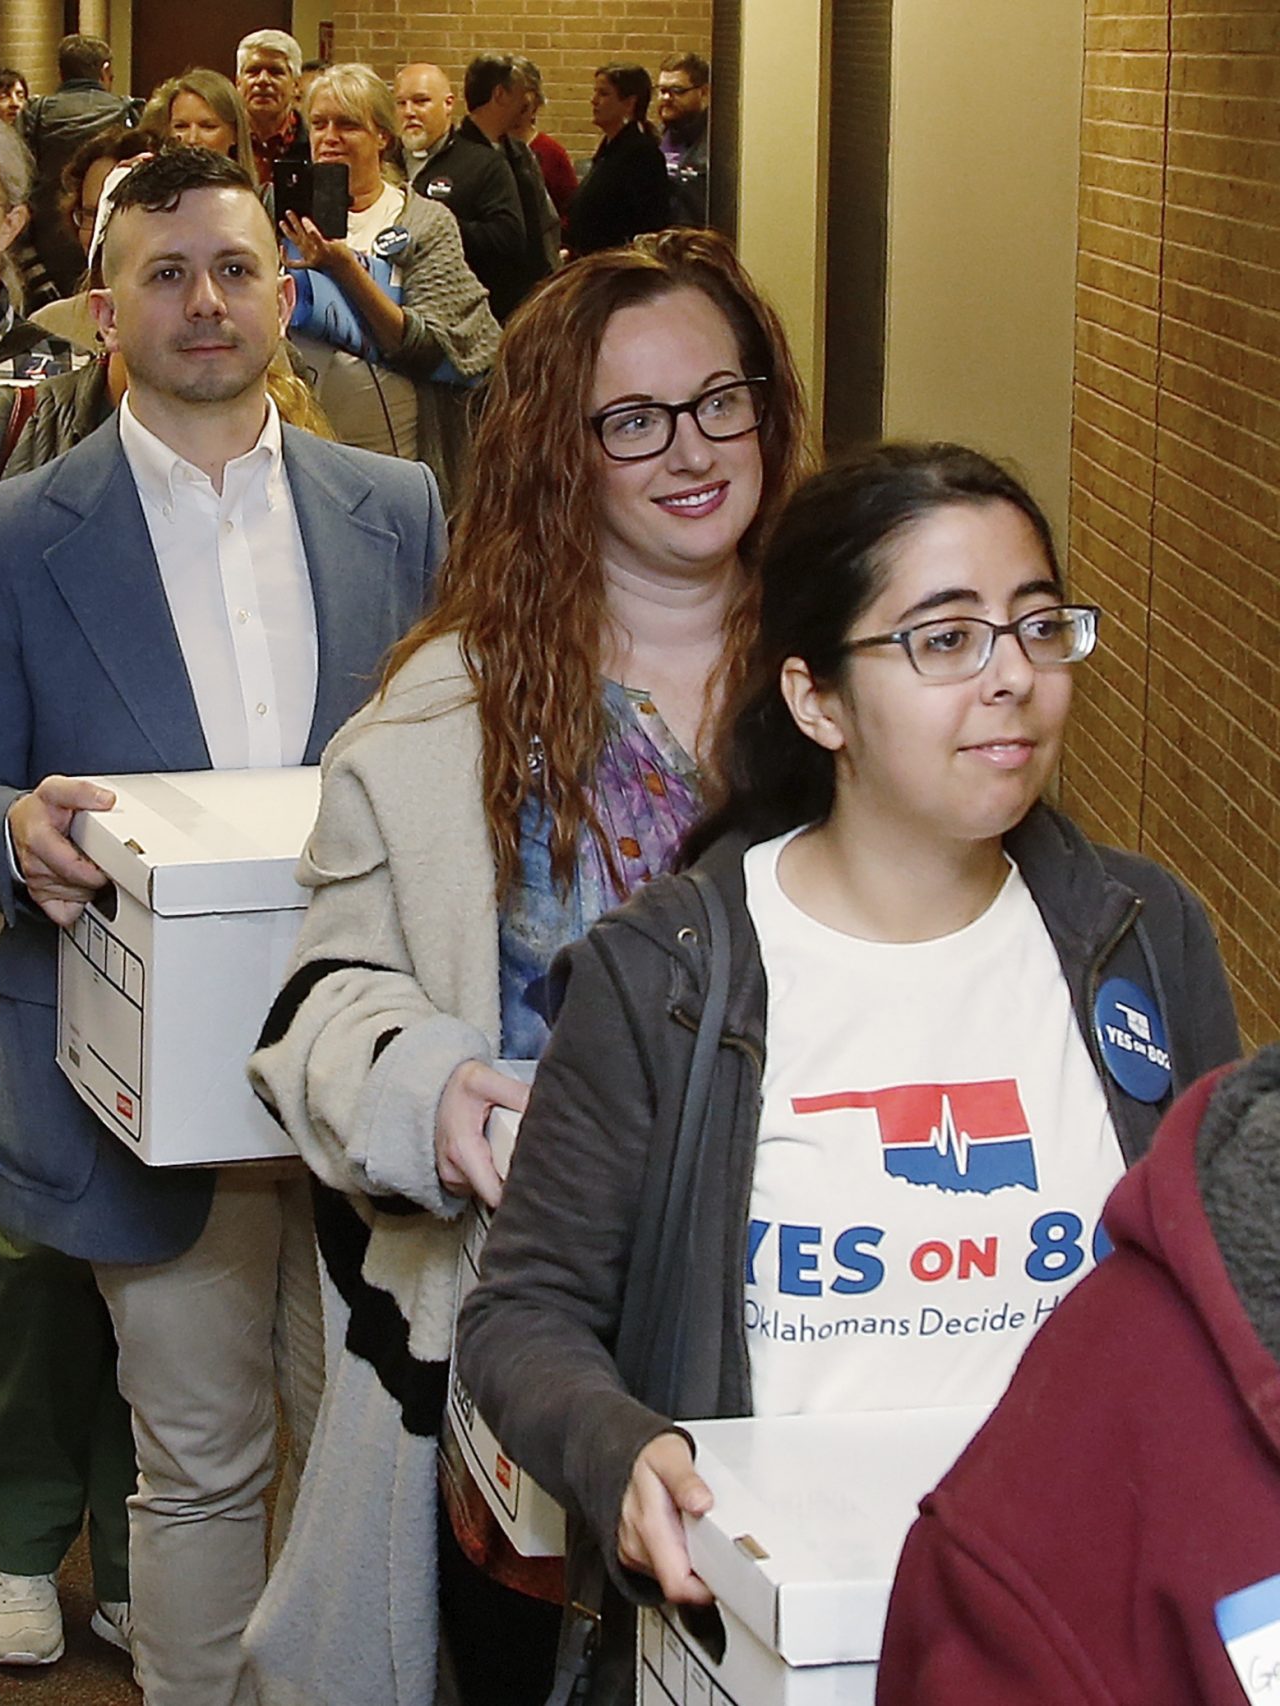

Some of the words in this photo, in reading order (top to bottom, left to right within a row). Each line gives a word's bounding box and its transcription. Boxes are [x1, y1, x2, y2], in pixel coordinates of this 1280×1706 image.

[1105, 1024, 1132, 1051] YES
[910, 1237, 998, 1282] ON
[1025, 1211, 1114, 1282] 8
[745, 1299, 911, 1342] Oklahomans
[918, 1302, 1026, 1336] Decide
